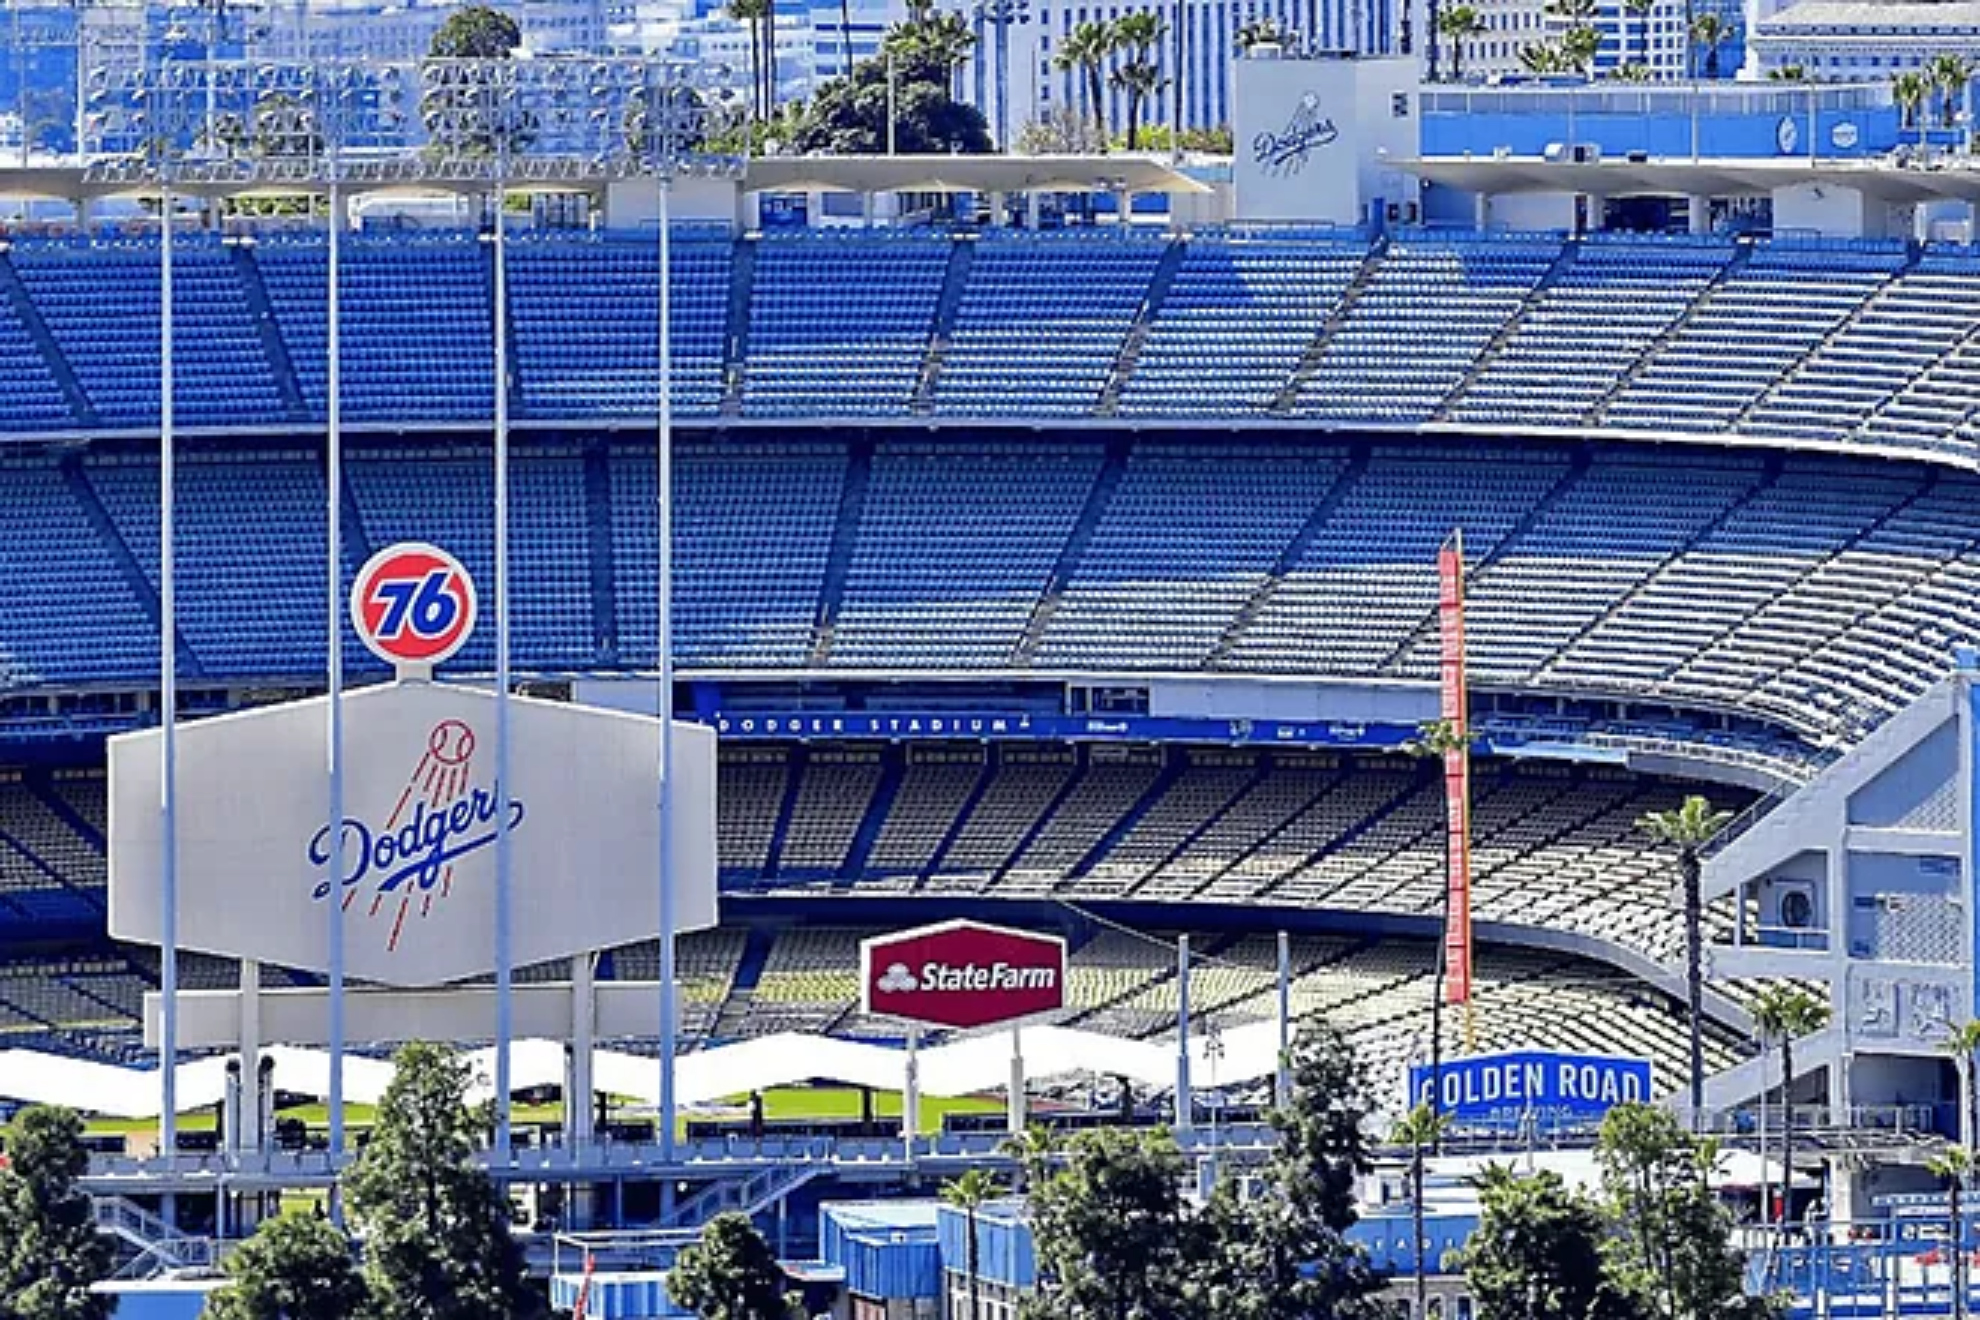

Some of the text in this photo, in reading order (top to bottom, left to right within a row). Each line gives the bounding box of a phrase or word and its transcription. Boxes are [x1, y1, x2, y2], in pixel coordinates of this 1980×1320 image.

[1253, 118, 1338, 165] Dodgers
[374, 569, 458, 639] 76
[719, 718, 843, 732] DODGER
[870, 718, 1007, 732] STADIUM
[1559, 1063, 1641, 1103] ROAD
